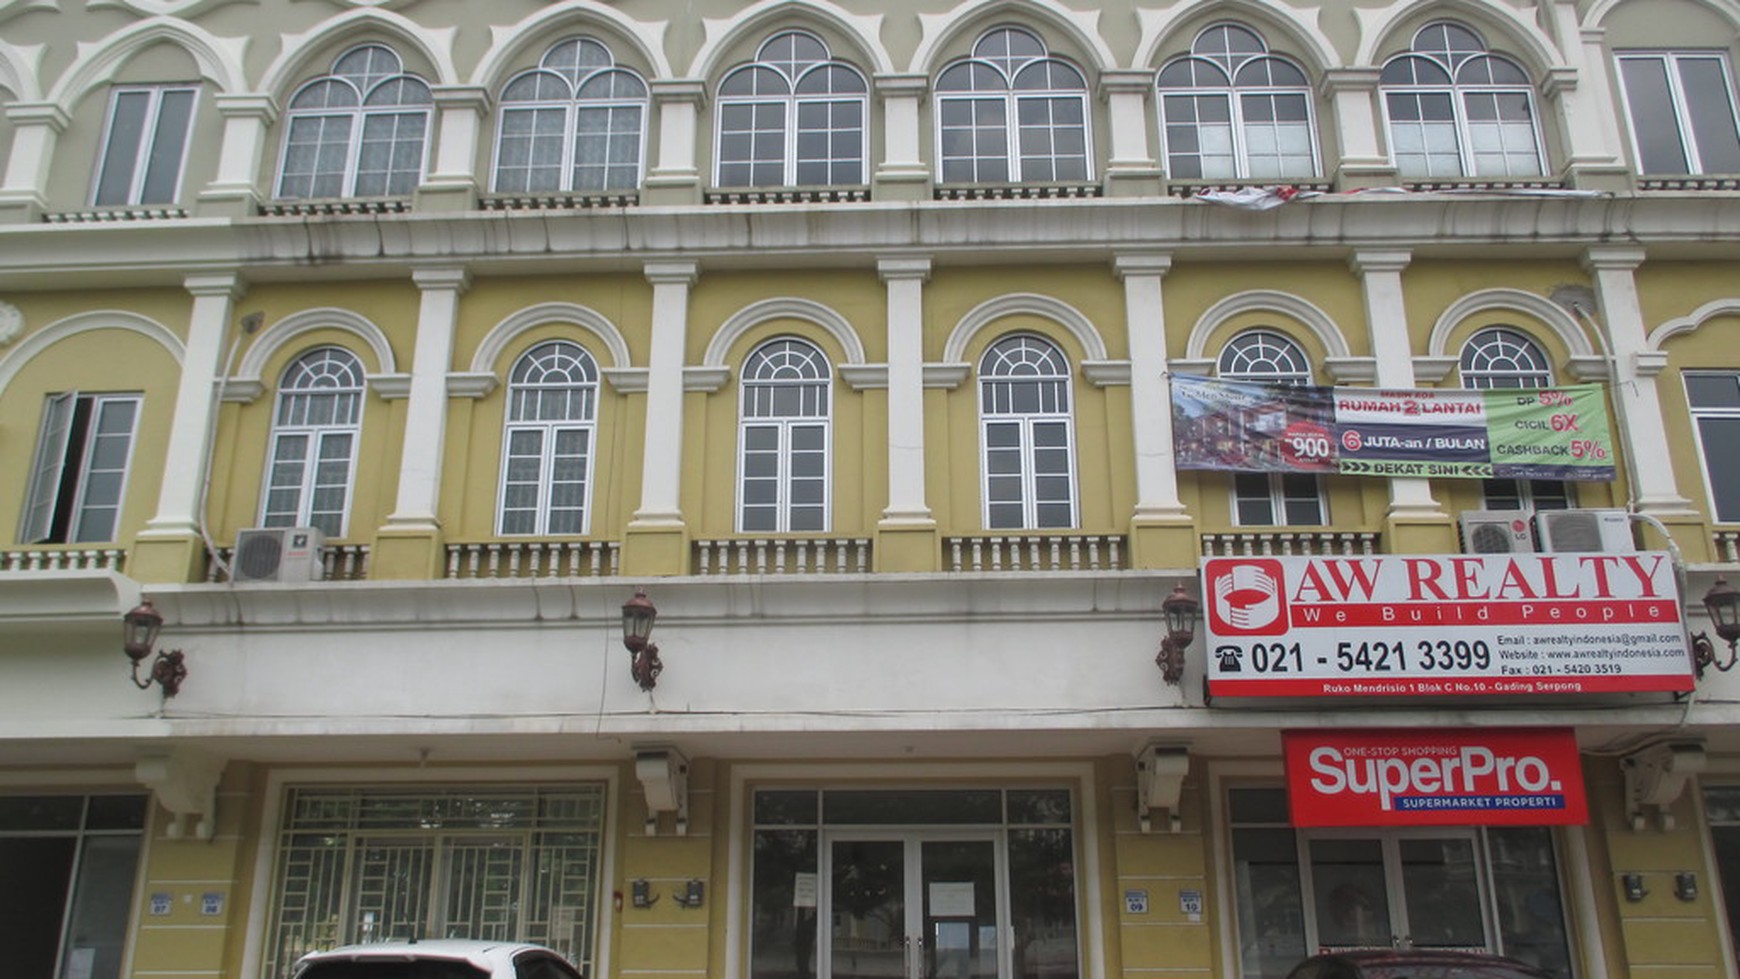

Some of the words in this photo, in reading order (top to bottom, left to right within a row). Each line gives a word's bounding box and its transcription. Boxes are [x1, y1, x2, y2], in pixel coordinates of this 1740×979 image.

[1516, 396, 1536, 406] DP
[1538, 389, 1574, 407] 5%
[1338, 400, 1401, 413] RUMAH
[1403, 400, 1421, 415] 2
[1421, 402, 1482, 414] LANTAI
[1514, 420, 1549, 431] CICIL
[1550, 413, 1579, 432] 6X
[1292, 437, 1330, 458] 900
[1341, 430, 1362, 451] 6
[1364, 436, 1423, 449] JUTA-an
[1434, 438, 1486, 450] BULAN
[1496, 444, 1570, 457] CASHBACK
[1570, 439, 1608, 460] 5%
[1373, 463, 1424, 475] DEKAT
[1428, 464, 1459, 475] SINI
[1291, 559, 1384, 603] AW
[1401, 555, 1665, 601] REALTY
[1303, 607, 1347, 623] We
[1381, 605, 1489, 621] Build
[1521, 603, 1660, 621] People
[1497, 634, 1525, 646] Email
[1533, 633, 1681, 647] awrealtyindonesia@gmail.com
[1251, 641, 1303, 673] 021
[1336, 640, 1407, 672] 5421
[1417, 639, 1491, 670] 3399
[1498, 649, 1539, 660] Website
[1546, 647, 1685, 661] www.awrealtyindonesia.com
[1501, 665, 1523, 676] Fax
[1532, 664, 1552, 675] 021
[1564, 663, 1592, 674] 5420
[1594, 663, 1622, 674] 3519
[1323, 683, 1351, 694] Ruko
[1353, 682, 1407, 694] Mendrisio
[1417, 681, 1442, 693] Blok
[1444, 681, 1453, 692] C
[1455, 681, 1486, 692] No.10
[1494, 681, 1534, 694] Gading
[1536, 680, 1582, 693] Serpong
[1343, 747, 1399, 757] ONE-STOP
[1401, 746, 1458, 756] SHOPPING
[1309, 746, 1562, 811] SuperPro.
[1403, 798, 1491, 808] SUPERMARKET
[1495, 797, 1556, 808] PROPERTI
